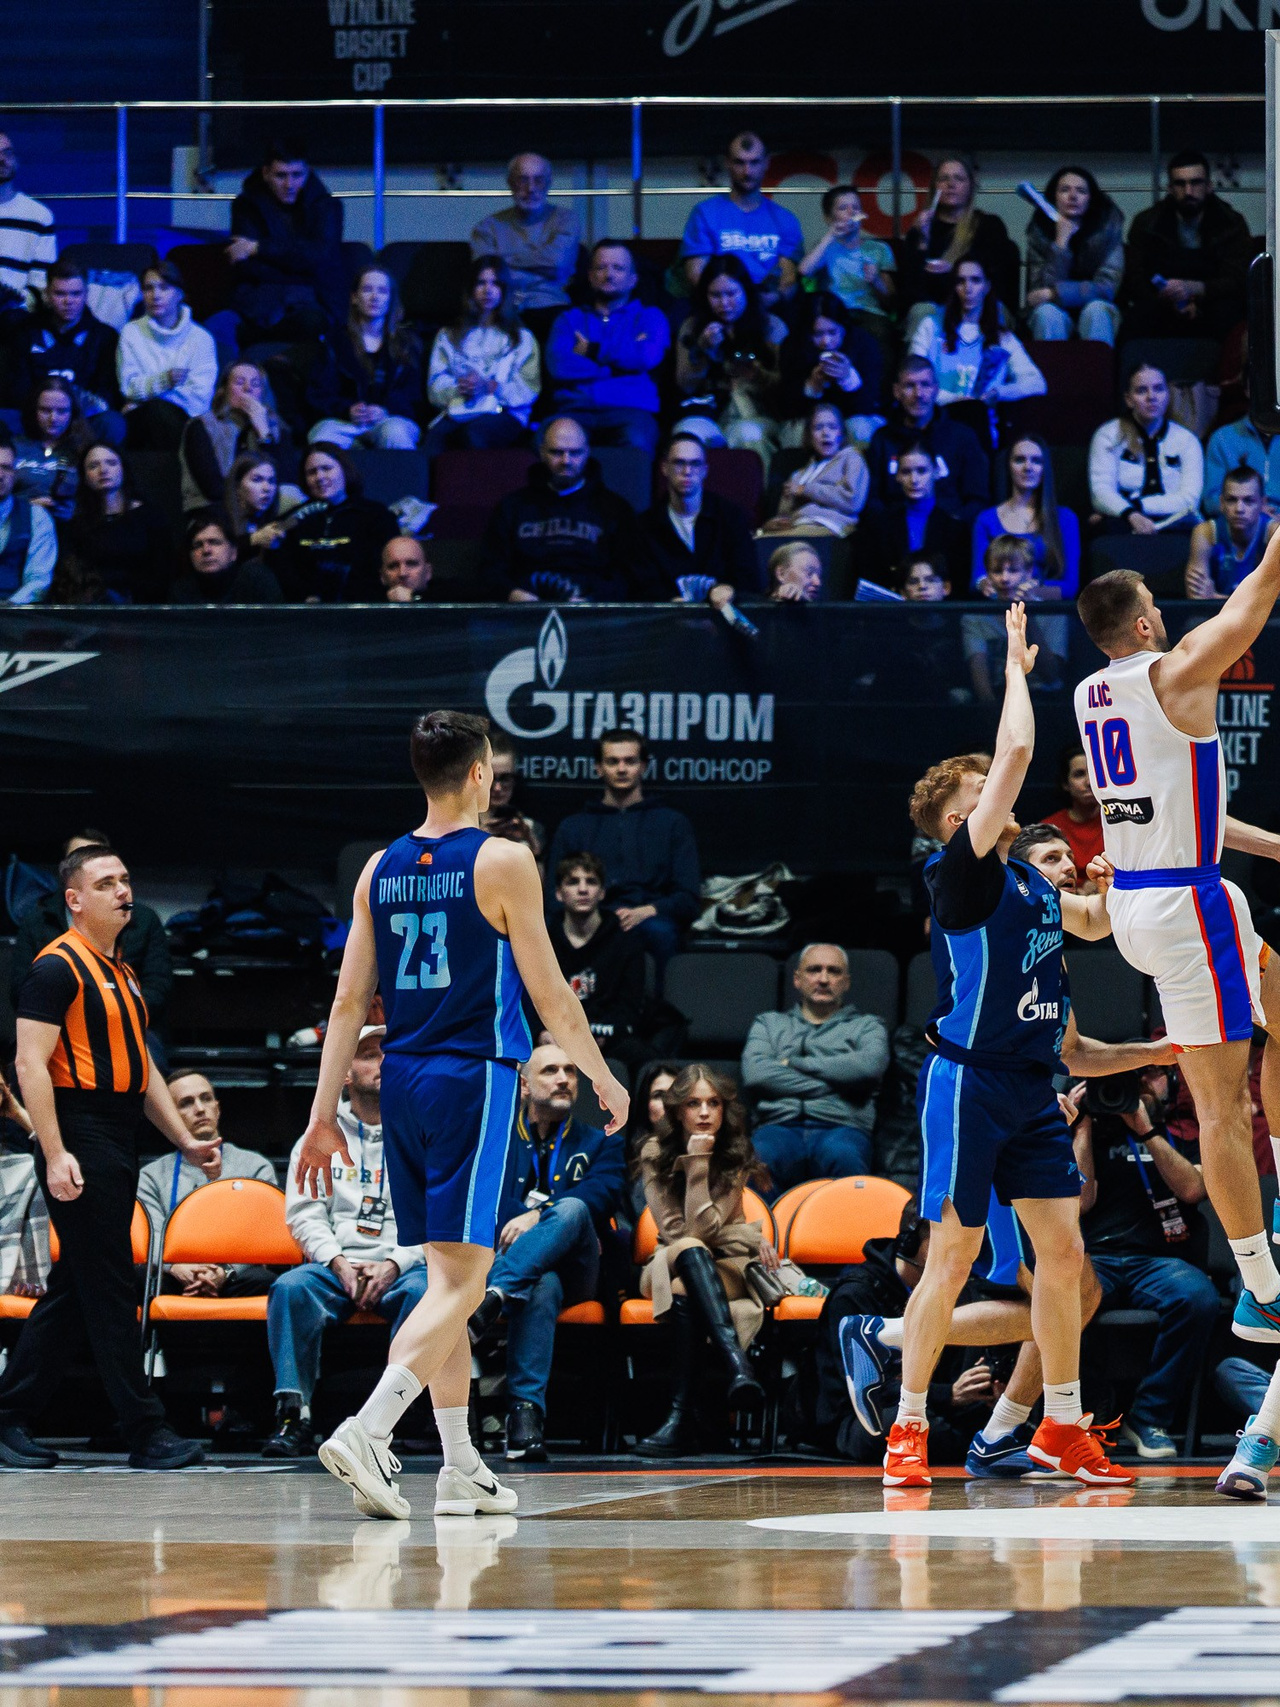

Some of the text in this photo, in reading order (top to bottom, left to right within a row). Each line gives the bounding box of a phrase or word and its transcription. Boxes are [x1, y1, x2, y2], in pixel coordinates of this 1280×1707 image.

[334, 29, 408, 59] BASKET
[353, 62, 391, 92] CUP
[1088, 681, 1113, 709] ILIĆ
[1217, 693, 1271, 727] LINE
[572, 691, 776, 742] ГАЗПРОМ
[1084, 717, 1138, 789] 10
[1219, 730, 1262, 765] KET
[514, 754, 772, 782] НЕРАЛЬЙ СПОНСОР
[379, 871, 465, 905] DIMITRIJEVIC
[1041, 893, 1061, 925] 35
[389, 911, 452, 990] 23
[1021, 927, 1064, 975] Зени
